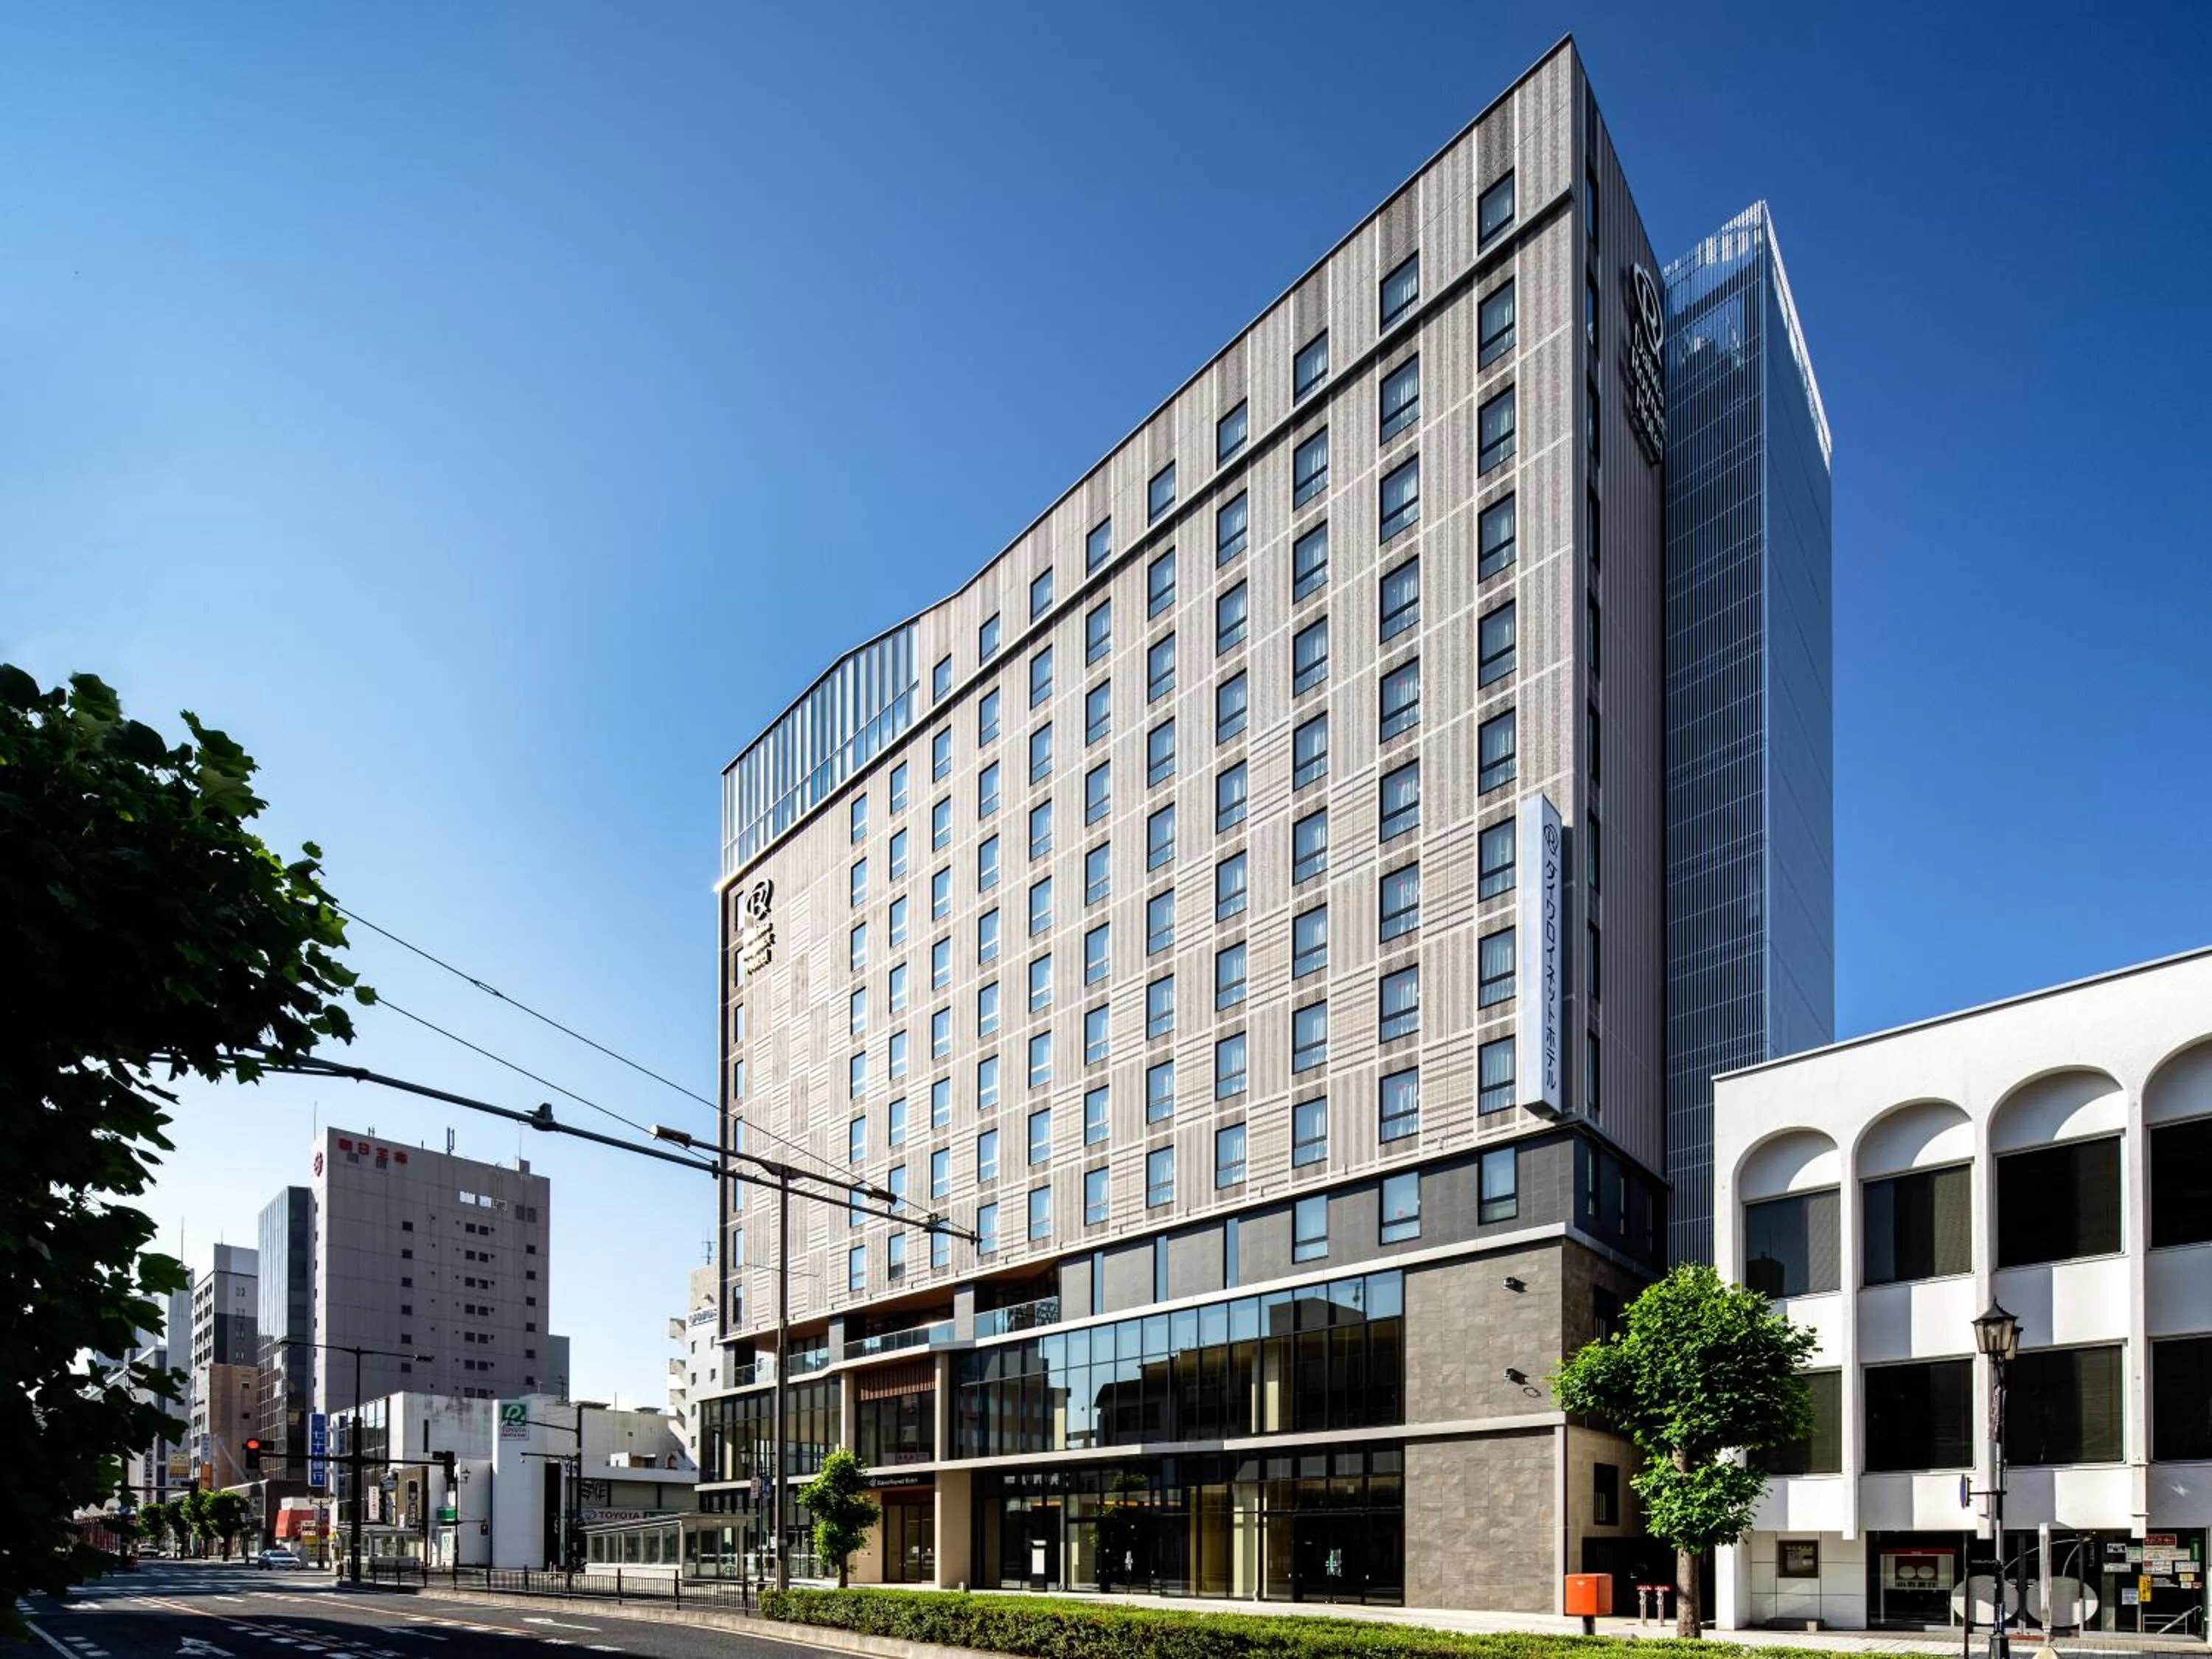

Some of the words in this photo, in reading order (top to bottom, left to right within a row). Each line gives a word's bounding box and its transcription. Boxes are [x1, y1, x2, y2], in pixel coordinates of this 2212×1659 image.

[1546, 859, 1557, 1090] ダイワロイネットホテル
[600, 1511, 641, 1520] TOYOTA
